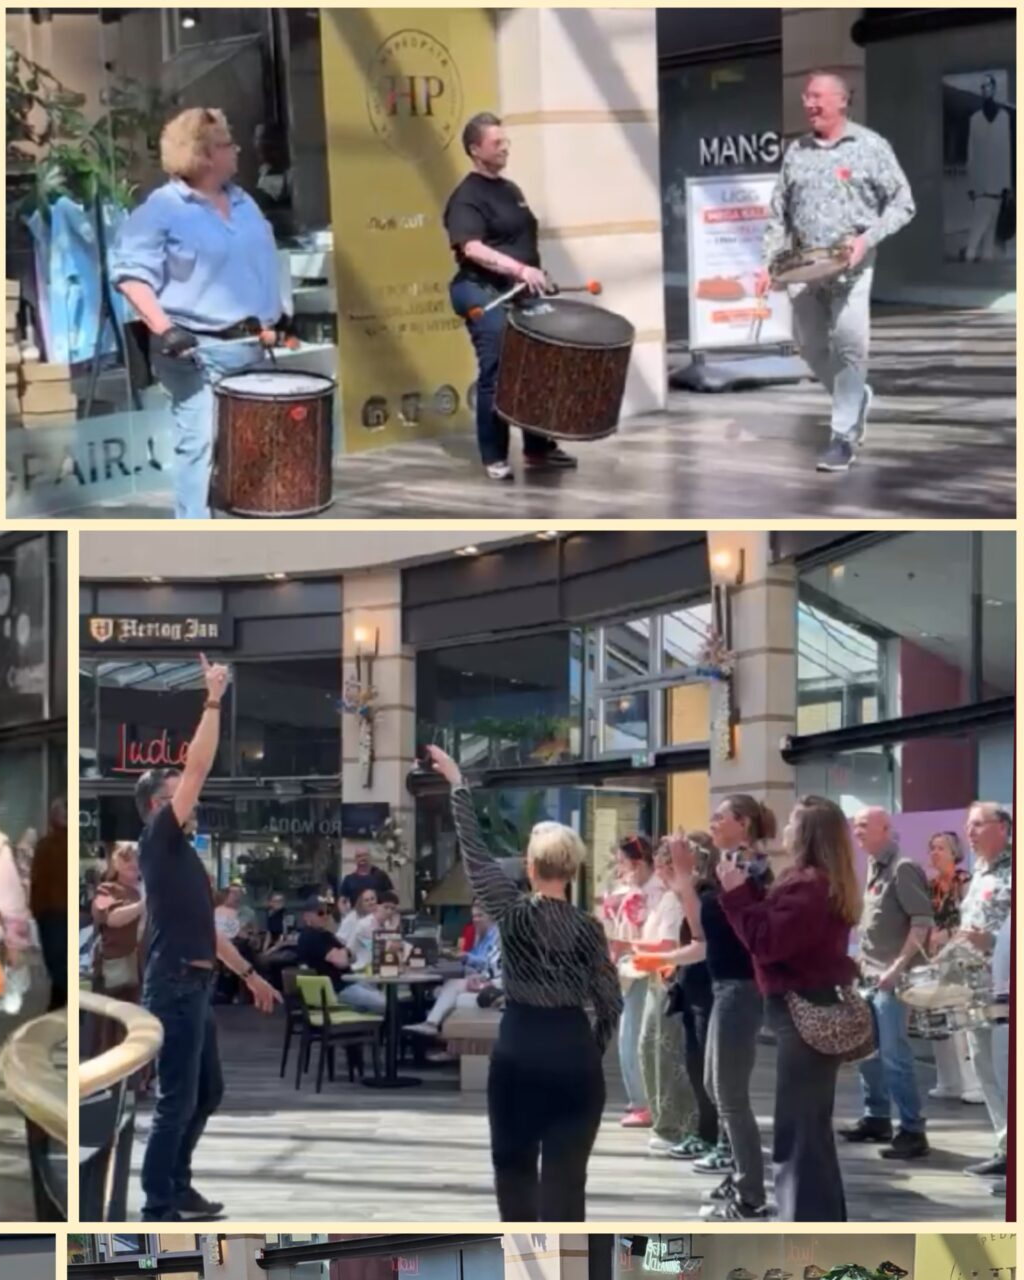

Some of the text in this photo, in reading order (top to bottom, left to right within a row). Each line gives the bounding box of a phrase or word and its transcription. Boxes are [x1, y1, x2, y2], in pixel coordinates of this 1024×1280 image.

[384, 75, 445, 117] HP
[118, 618, 219, 642] Hertog Jan
